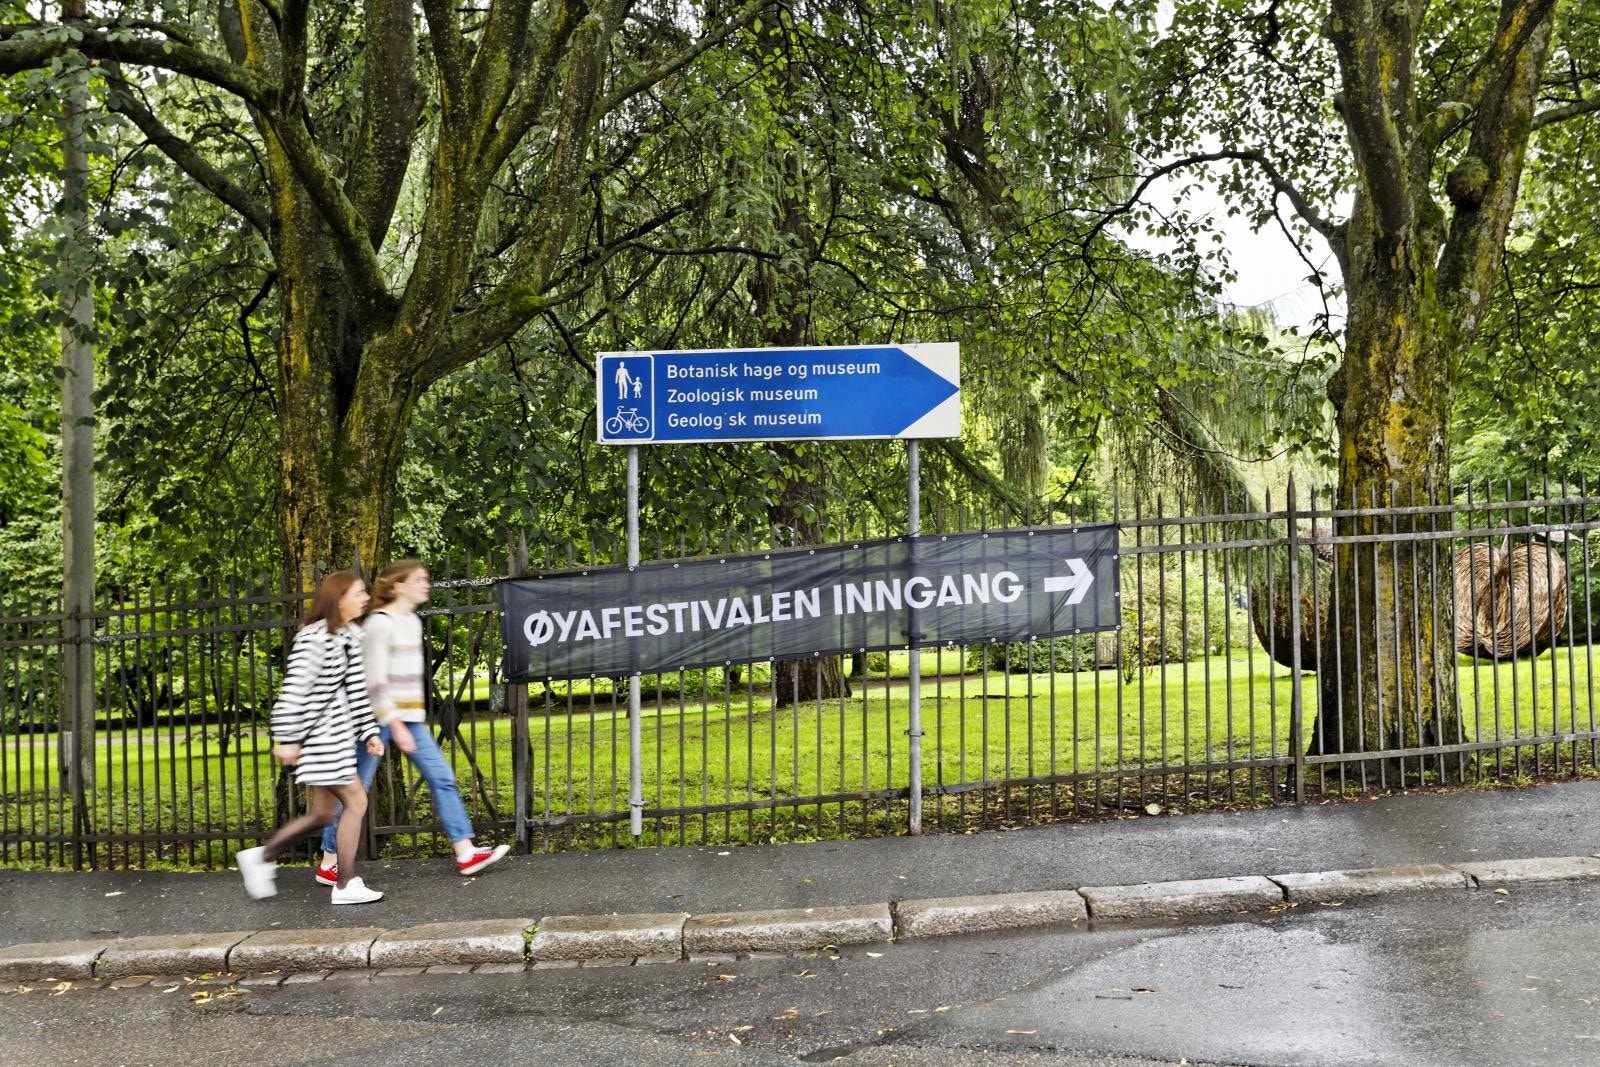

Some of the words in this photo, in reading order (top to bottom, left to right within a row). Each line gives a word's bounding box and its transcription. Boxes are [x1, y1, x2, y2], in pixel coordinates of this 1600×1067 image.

[667, 364, 738, 379] Botanisk
[743, 364, 783, 380] hage
[788, 364, 808, 379] og
[812, 363, 881, 375] museum
[667, 388, 744, 406] Zoologisk
[750, 389, 818, 401] museum
[668, 412, 747, 430] Geologsk
[753, 413, 822, 426] museum
[523, 587, 821, 647] ØYAFESTIVALEN
[833, 570, 1025, 616] INNGANG
